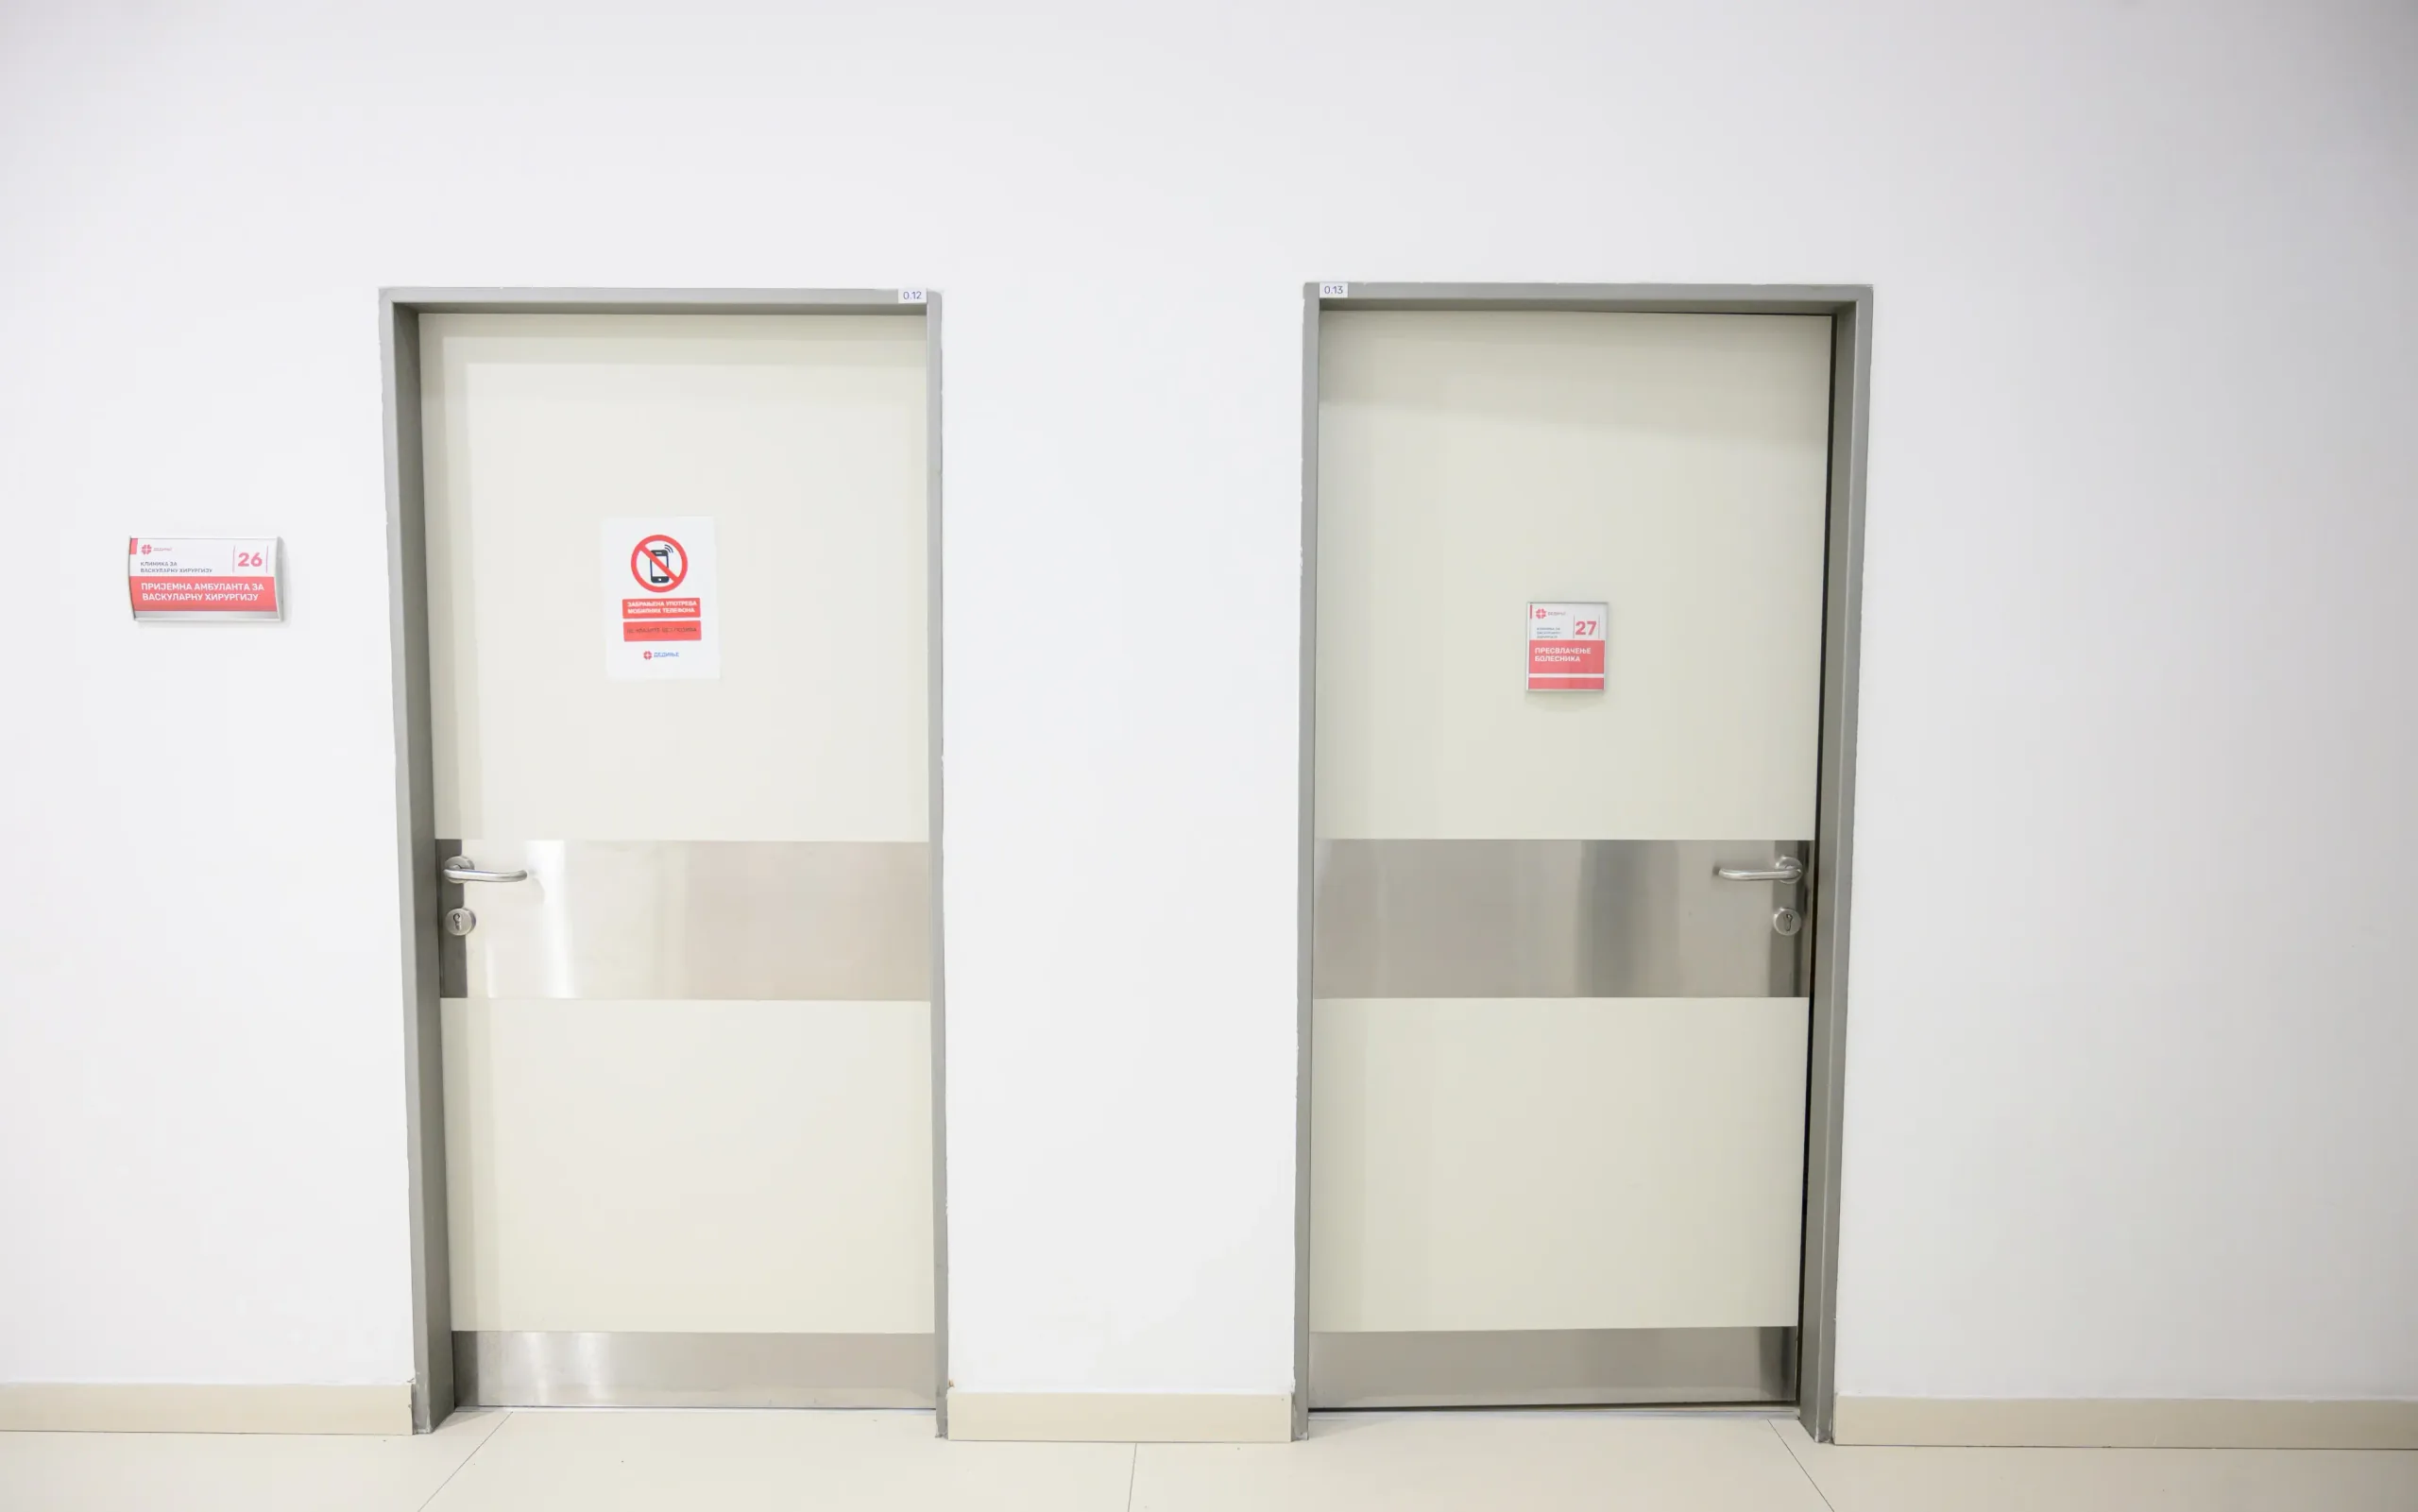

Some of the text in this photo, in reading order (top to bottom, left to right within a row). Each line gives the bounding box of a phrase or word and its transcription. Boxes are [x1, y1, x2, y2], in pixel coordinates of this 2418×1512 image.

[1324, 285, 1343, 295] 0.13
[903, 291, 922, 300] 0.12
[238, 552, 263, 567] 26
[141, 583, 265, 591] ПРИЈЕМНА АМБУЛАНТА ЗА
[142, 593, 259, 602] ВАСКУЛАРНУ ХИРУРГИЈУ
[1575, 620, 1597, 636] 27
